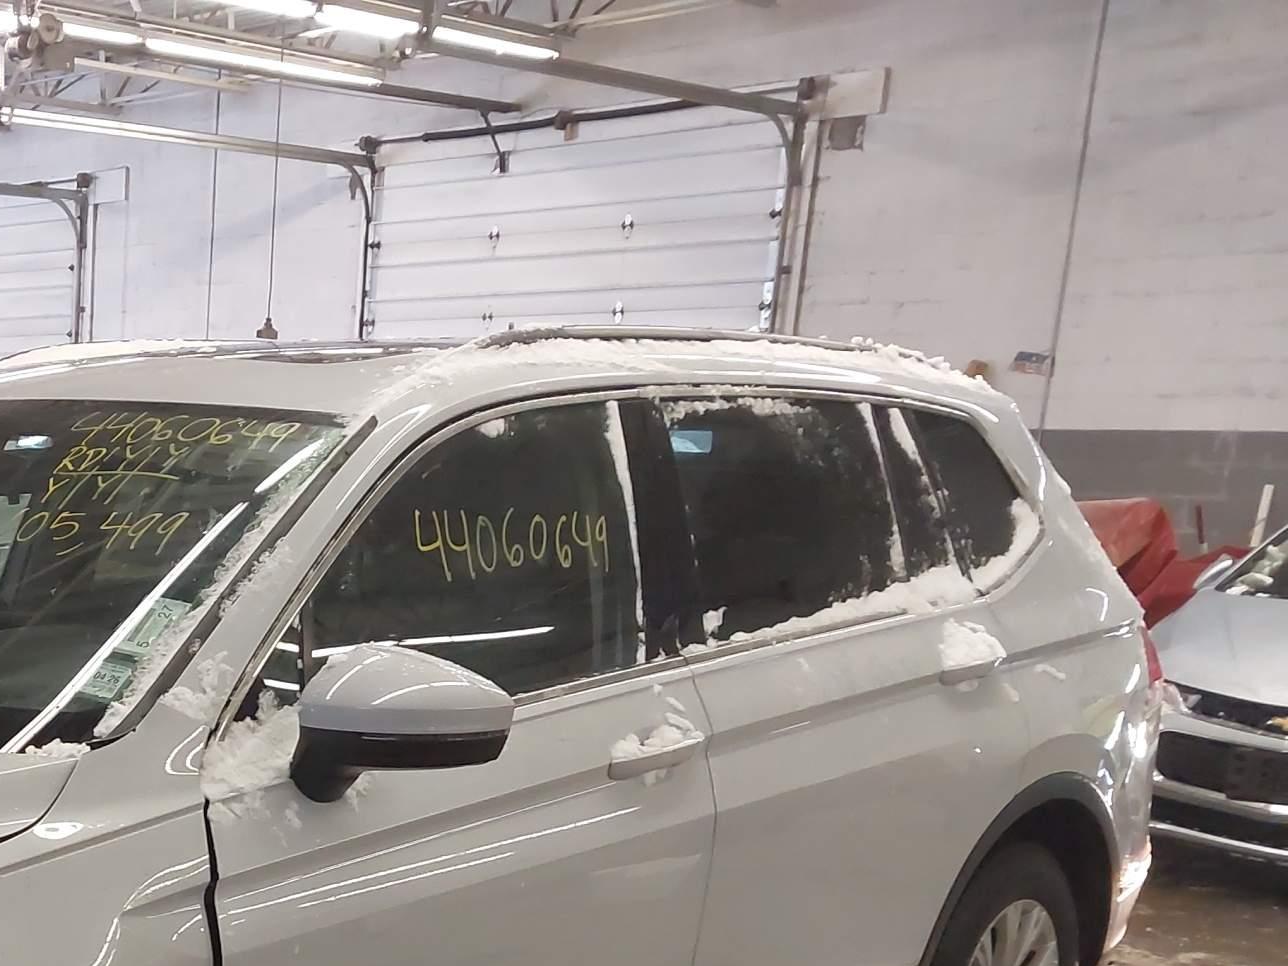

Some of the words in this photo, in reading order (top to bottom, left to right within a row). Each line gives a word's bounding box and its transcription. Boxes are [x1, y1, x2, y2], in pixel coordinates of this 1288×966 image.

[70, 410, 302, 453] 44060649
[98, 510, 191, 556] 499
[413, 506, 610, 583] 44060649
[157, 604, 174, 620] 27
[136, 641, 150, 649] 5
